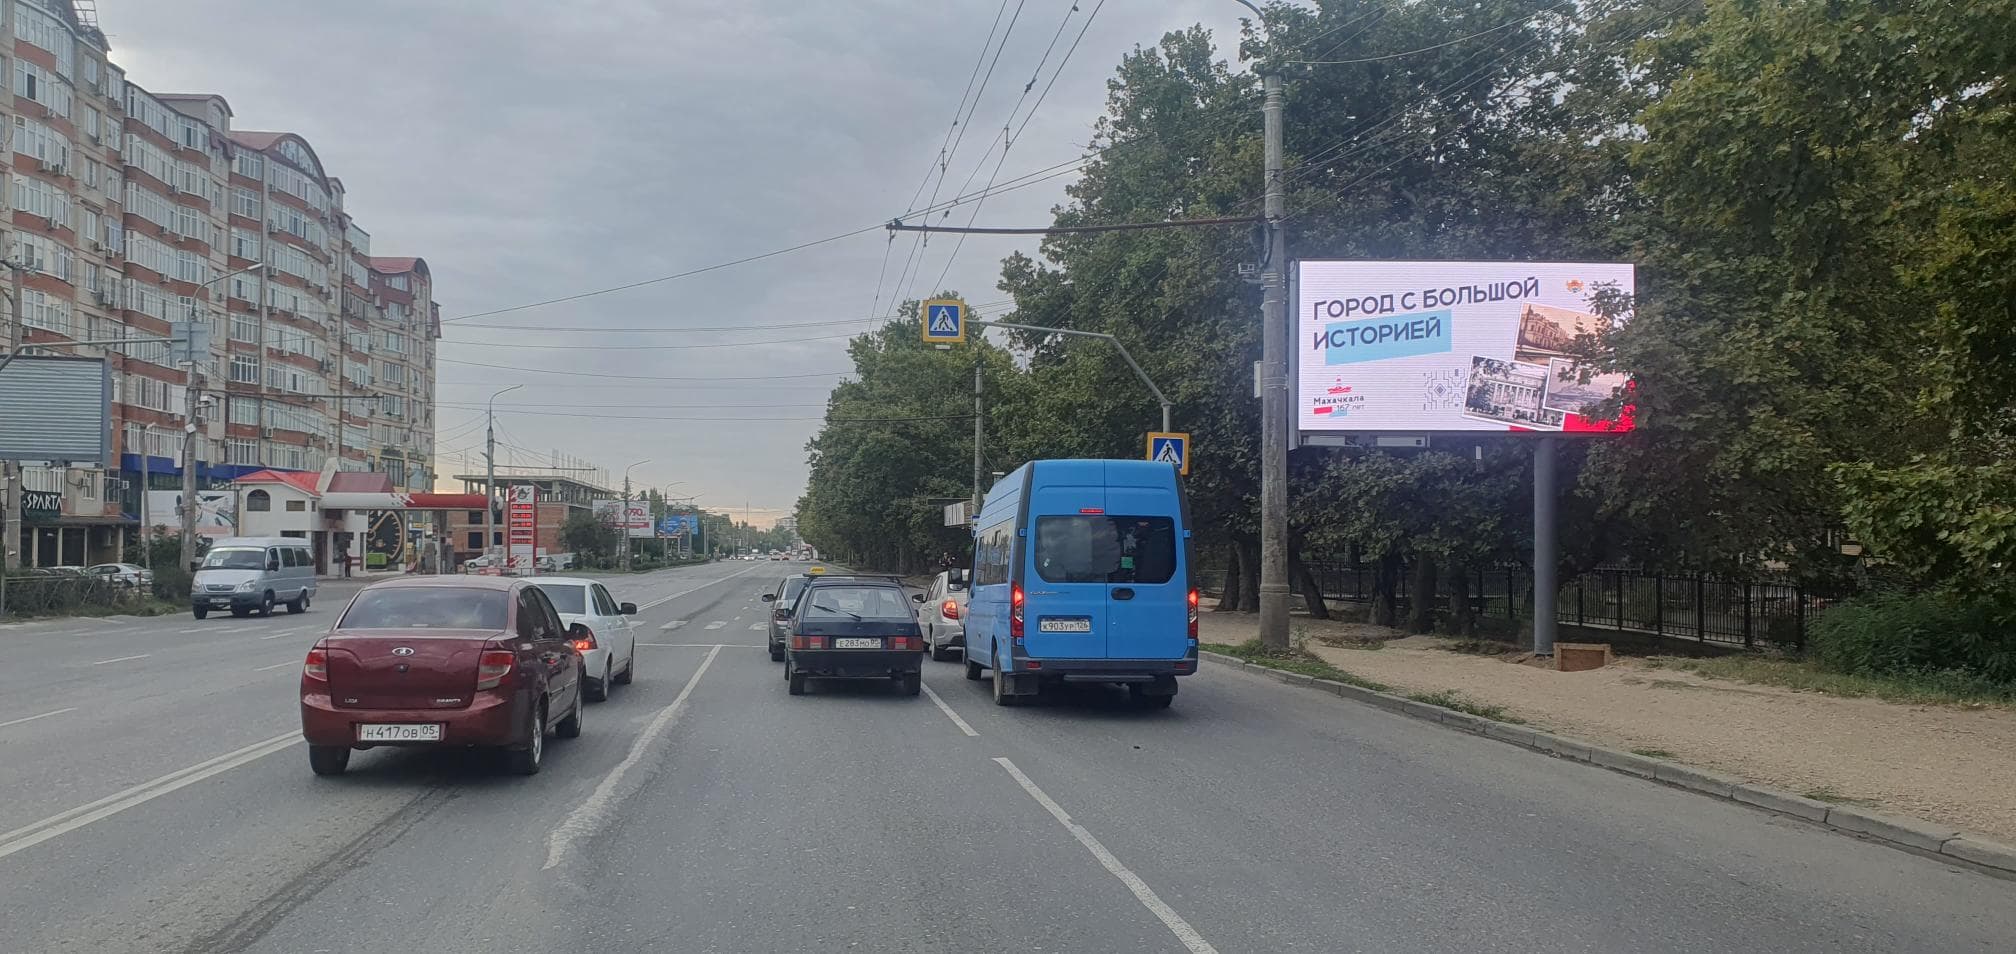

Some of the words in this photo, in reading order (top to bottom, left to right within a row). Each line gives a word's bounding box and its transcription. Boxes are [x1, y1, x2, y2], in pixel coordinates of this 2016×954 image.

[1313, 294, 1395, 321] ГОРОД
[1400, 292, 1417, 310] С
[1423, 276, 1540, 309] БОЛЬШОЙ
[1313, 316, 1441, 351] ИСТОРИЕЙ
[1313, 395, 1365, 406] Махачкала
[27, 493, 63, 510] SPARTA
[422, 726, 436, 735] 05
